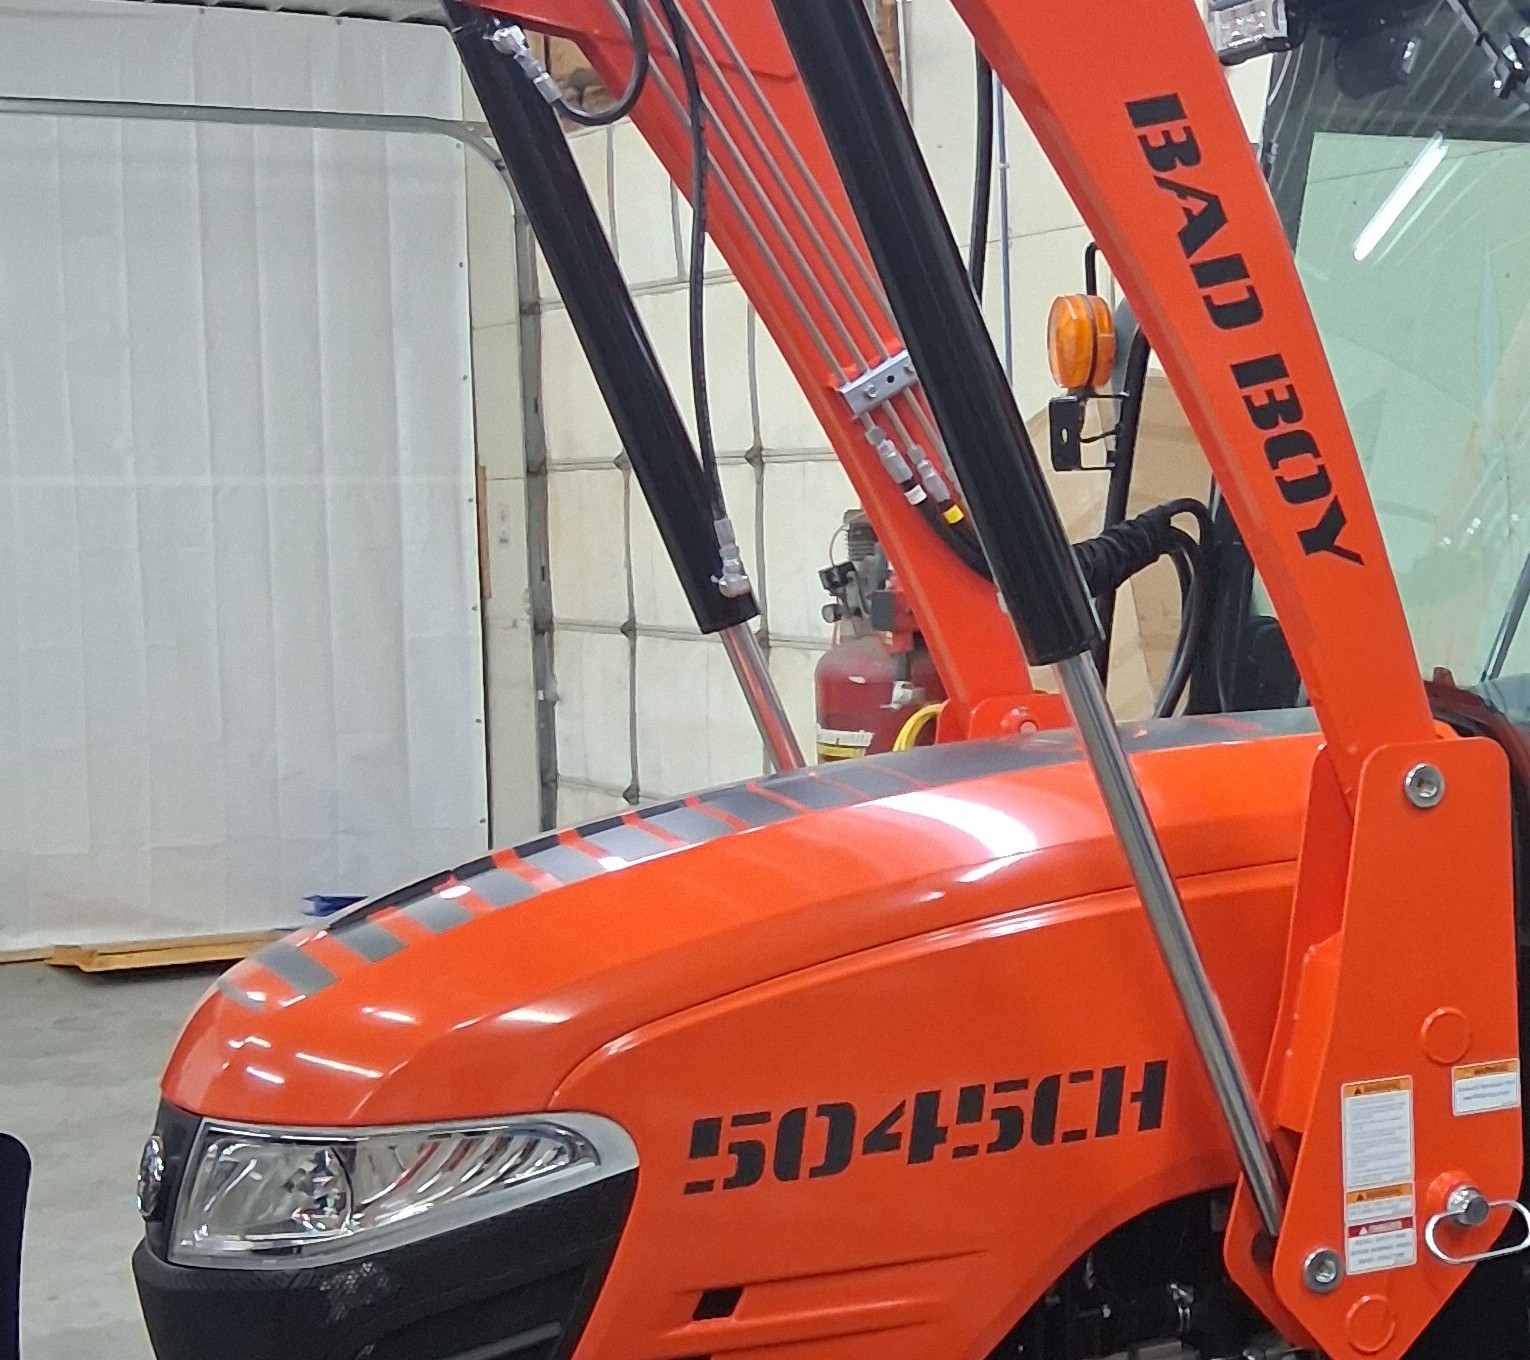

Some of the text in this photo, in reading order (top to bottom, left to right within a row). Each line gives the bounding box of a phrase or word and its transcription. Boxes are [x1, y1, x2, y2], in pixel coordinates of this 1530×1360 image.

[1125, 92, 1364, 566] BAD BOY
[683, 1059, 1169, 1196] 5045CH
